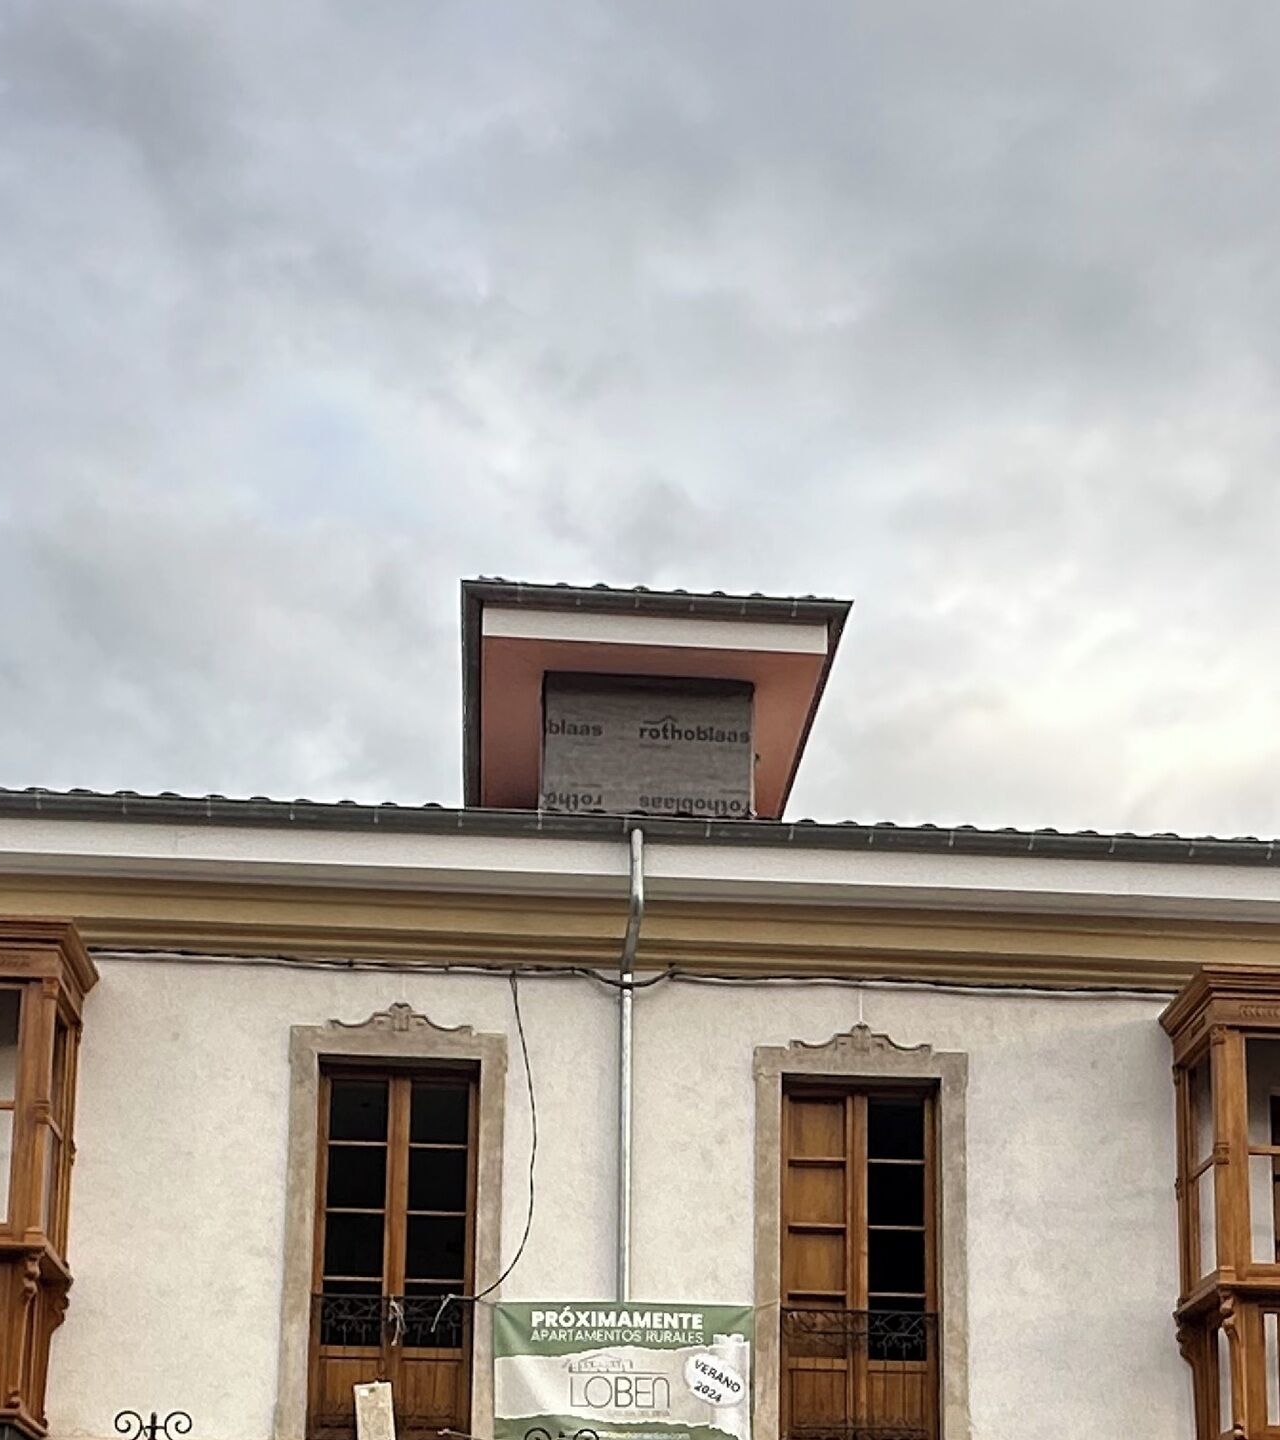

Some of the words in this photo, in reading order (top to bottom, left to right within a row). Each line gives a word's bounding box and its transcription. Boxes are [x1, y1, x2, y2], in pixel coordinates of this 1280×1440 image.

[639, 722, 750, 744] rothoblaas
[531, 1305, 704, 1330] PRÓXIMAMENTE
[530, 1328, 642, 1343] APARTAMENTOS
[646, 1330, 704, 1344] RURALES
[695, 1359, 741, 1393] VERANO
[570, 1375, 670, 1409] LOBEN
[694, 1380, 722, 1403] 2024
